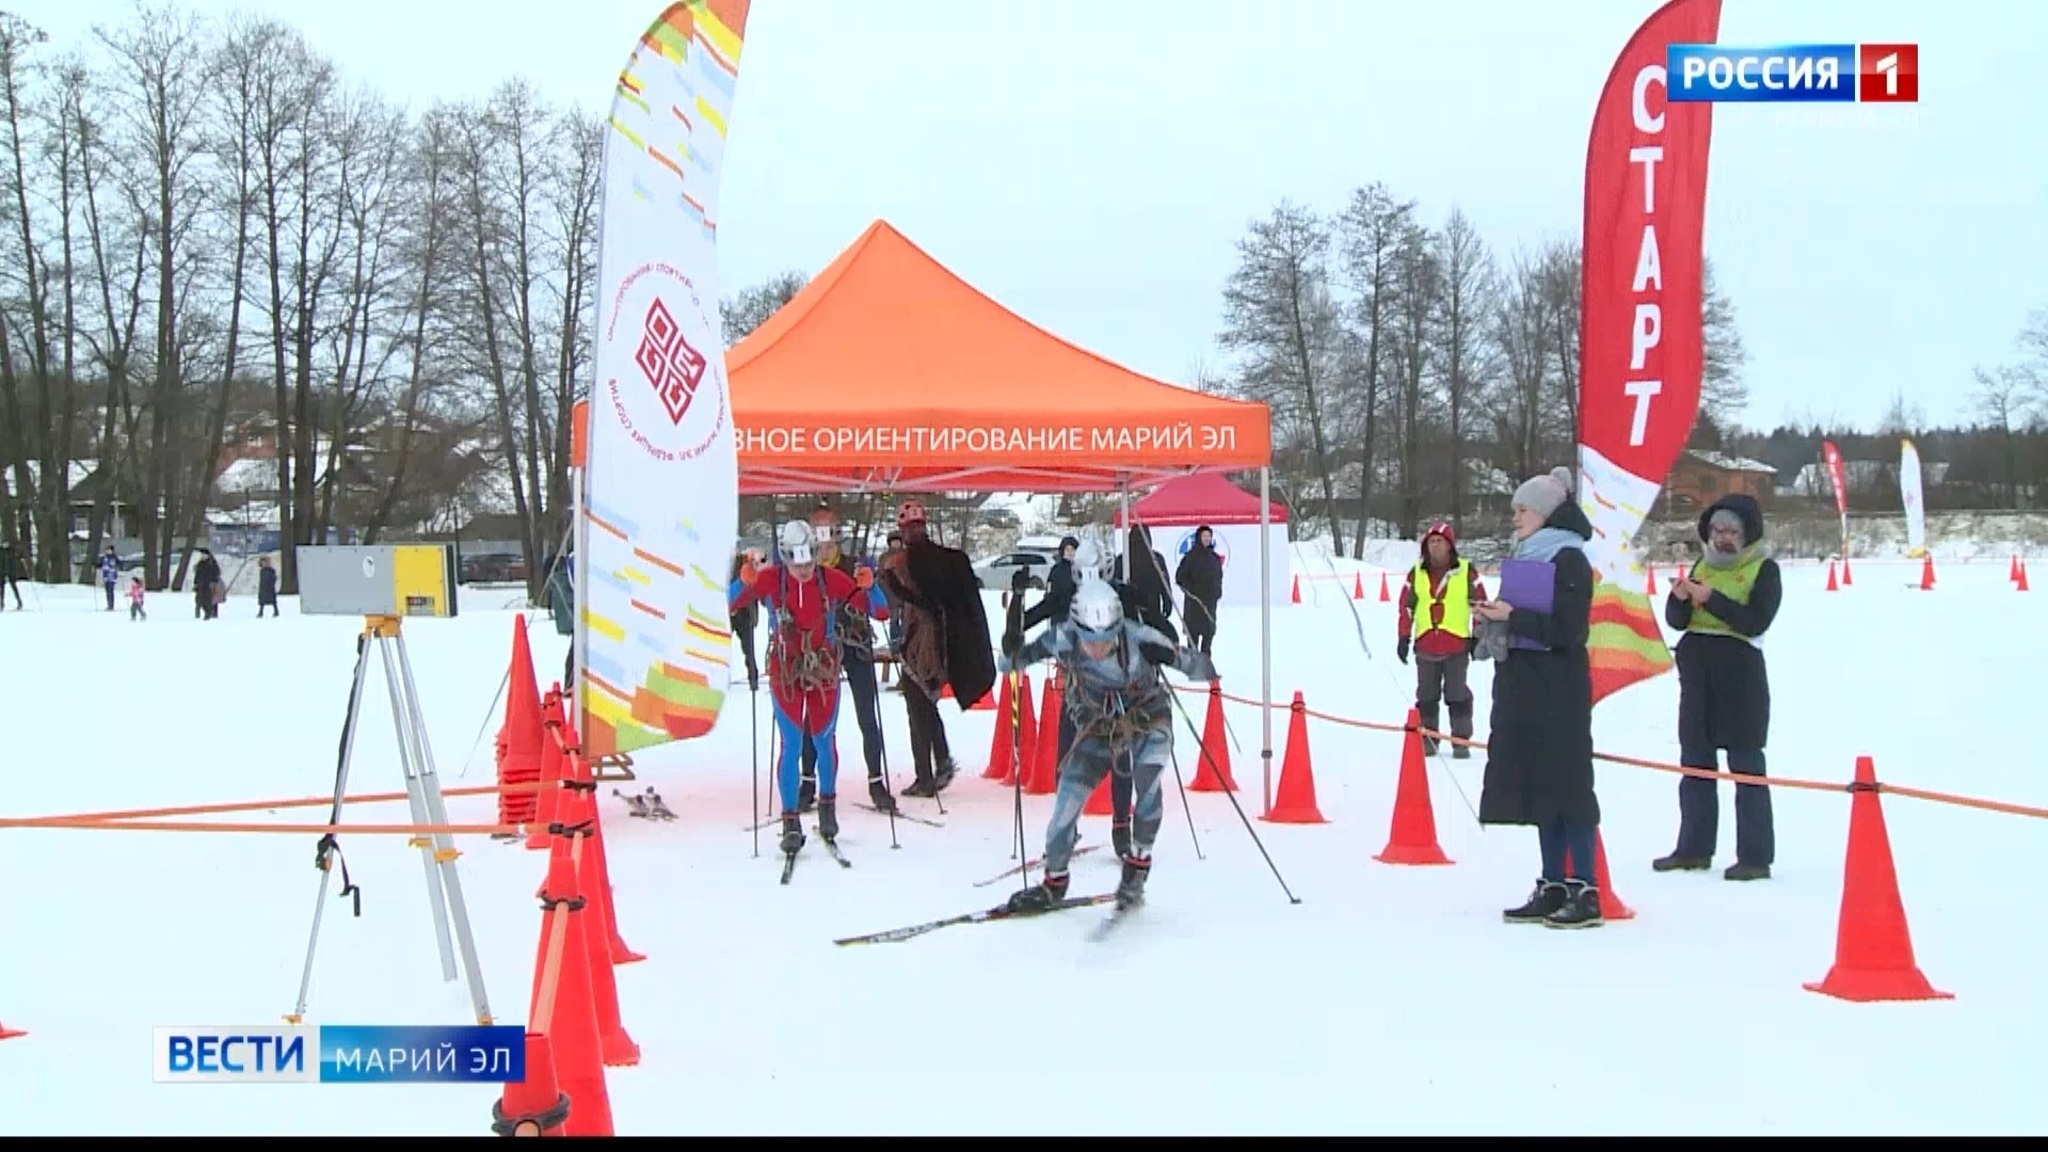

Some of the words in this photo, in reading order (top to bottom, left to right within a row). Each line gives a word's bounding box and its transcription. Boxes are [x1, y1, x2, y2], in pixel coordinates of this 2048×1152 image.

[1623, 64, 1668, 446] СТАРТ
[813, 426, 1084, 452] ОРИЕНТИРОВАНИЕ
[1091, 421, 1193, 450] МАРИЙ
[1200, 425, 1236, 450] ЭЛ
